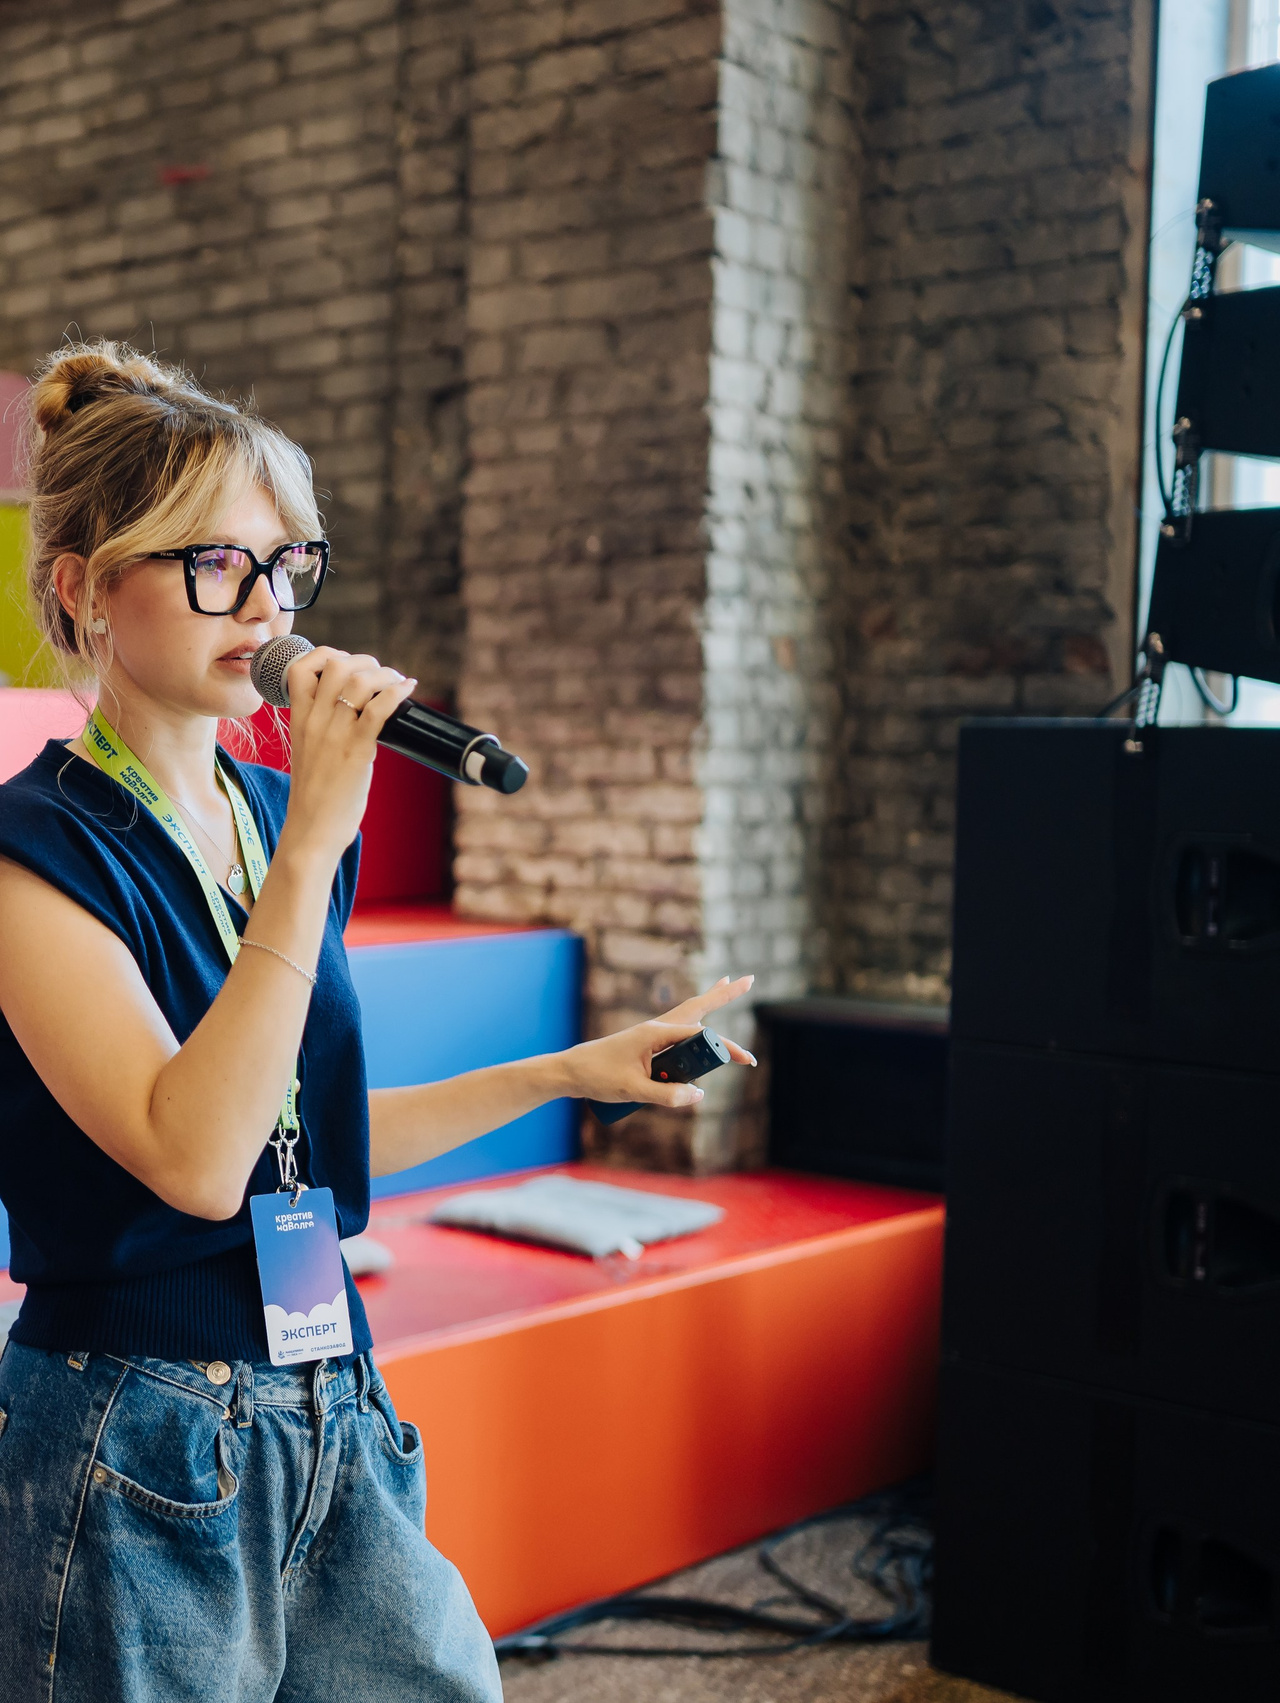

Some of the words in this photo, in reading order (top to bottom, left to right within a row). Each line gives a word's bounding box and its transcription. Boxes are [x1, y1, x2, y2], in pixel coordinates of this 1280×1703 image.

[162, 814, 207, 876] ЭКСПЕРТ
[275, 1211, 314, 1225] креатив
[281, 1322, 337, 1341] ЭКСПЕРТ
[310, 1342, 346, 1353] СТАНКОЗАВОД
